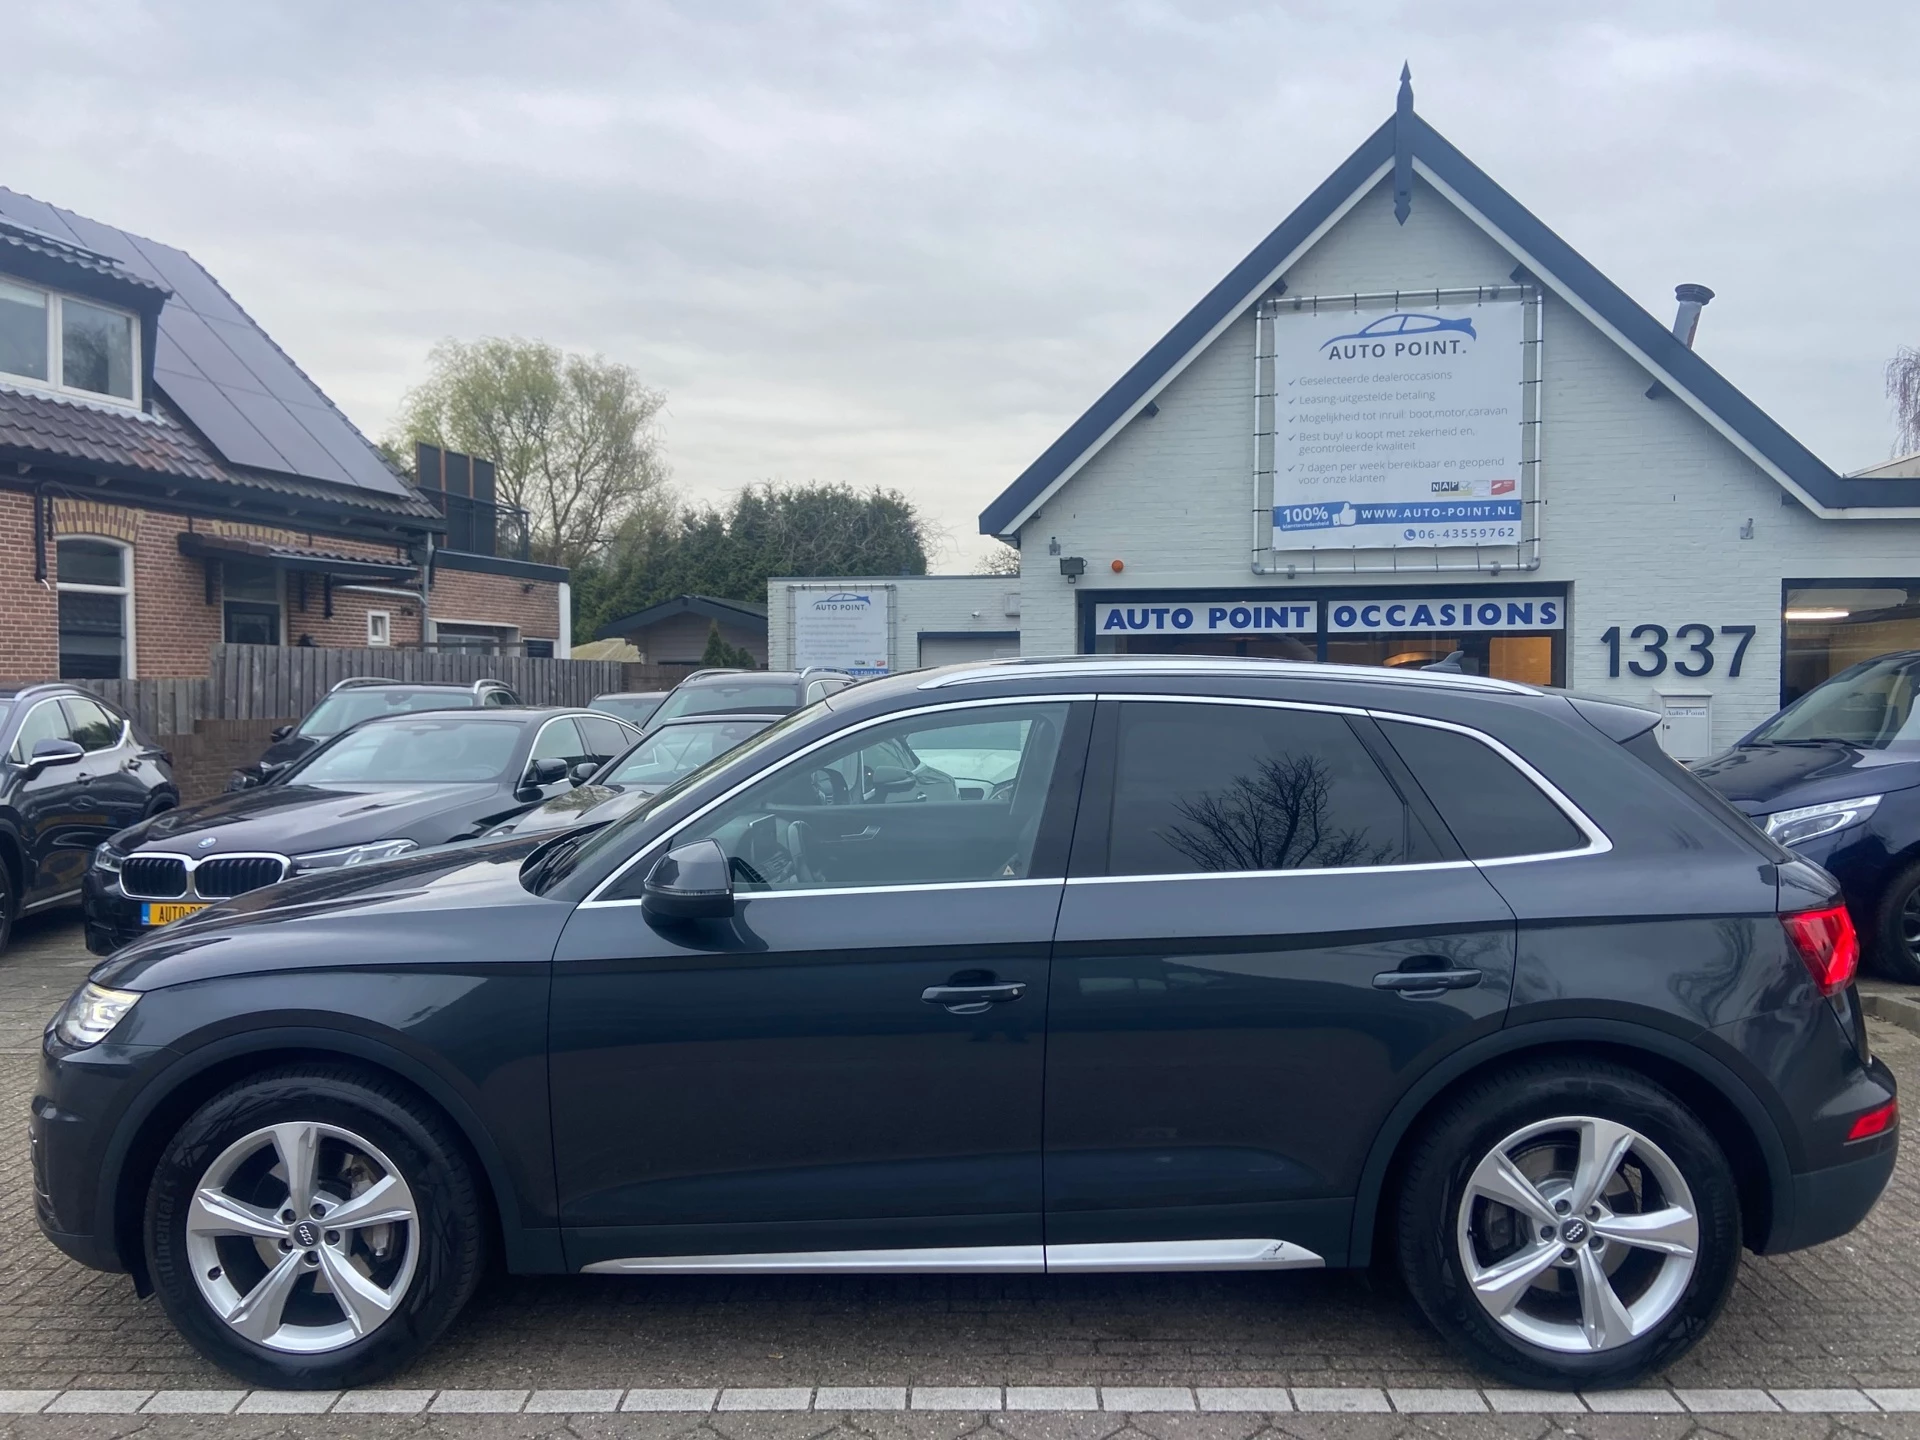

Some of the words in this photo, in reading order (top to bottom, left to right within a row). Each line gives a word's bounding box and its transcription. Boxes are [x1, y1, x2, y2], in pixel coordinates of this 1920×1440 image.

[1328, 343, 1386, 360] AUTO
[1395, 339, 1467, 357] POINT.
[1299, 374, 1370, 386] Geselecteerde
[1372, 371, 1453, 383] dealeroccasions
[1395, 390, 1436, 402] betaling
[1299, 411, 1360, 425] Mogelijkheid
[1362, 412, 1376, 421] tot
[1299, 432, 1320, 442] Best
[1323, 431, 1344, 443] buy!
[1355, 430, 1384, 441] koopt
[1386, 430, 1406, 438] met
[1408, 426, 1458, 438] zekerheid
[1298, 442, 1374, 456] gecontroleerde
[1376, 441, 1416, 452] kwaliteit
[1299, 463, 1305, 473] 7
[1307, 462, 1338, 474] dagen
[1340, 463, 1357, 473] per
[1359, 460, 1385, 471] week
[1387, 458, 1441, 470] bereikbaar
[1443, 460, 1457, 469] en
[1458, 456, 1506, 470] geopend
[1298, 476, 1321, 485] voor
[1322, 475, 1347, 484] onze
[1349, 473, 1386, 484] klanten
[1432, 481, 1459, 492] NAP
[1282, 506, 1329, 523] 100%
[1361, 506, 1516, 519] WWW.AUTO-POINT.NL
[1418, 527, 1515, 539] 06-43559762
[1103, 607, 1194, 630] AUTO
[1208, 606, 1311, 629] POINT
[1333, 601, 1557, 628] OCCASIONS
[1600, 623, 1757, 677] 1337
